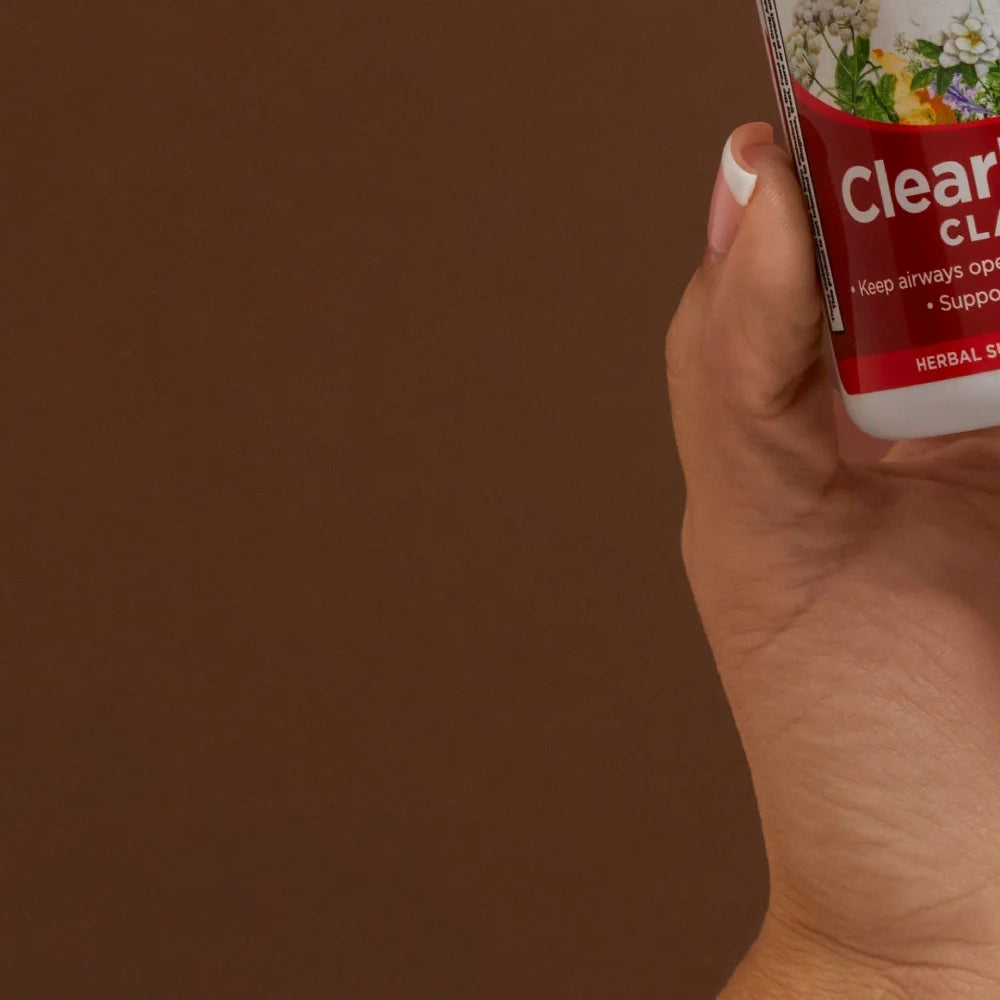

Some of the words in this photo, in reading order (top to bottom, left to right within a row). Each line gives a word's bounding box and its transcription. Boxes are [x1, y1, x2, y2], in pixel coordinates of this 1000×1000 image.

[858, 278, 894, 297] Keep
[899, 264, 964, 290] airways
[915, 348, 983, 372] HERBAL
